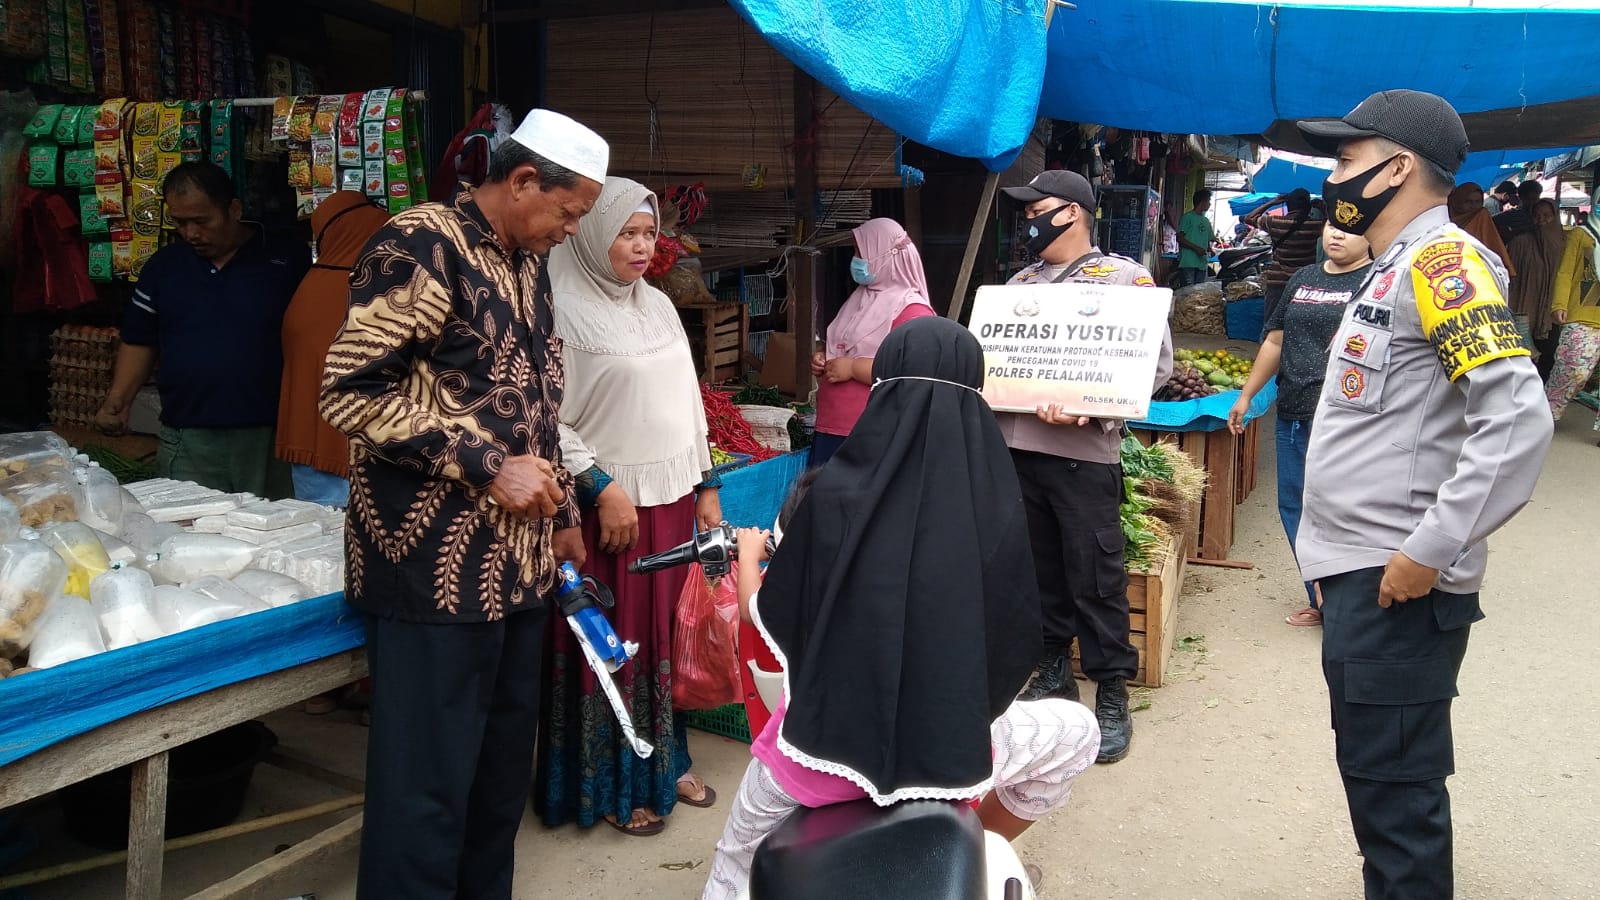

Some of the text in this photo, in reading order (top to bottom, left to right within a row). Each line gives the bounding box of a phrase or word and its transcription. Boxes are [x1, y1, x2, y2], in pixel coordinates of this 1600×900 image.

[1427, 257, 1458, 274] RIAU
[1353, 303, 1391, 327] POLRI
[980, 323, 1146, 343] OPERASI YUSTISI
[981, 344, 1148, 358] DISIPLINAN KEPATUHAN PROTOKOL KESEHATAN
[1466, 342, 1492, 361] AIR
[1007, 356, 1059, 366] PENCEGAHAN
[1061, 358, 1087, 367] COVID
[988, 366, 1113, 384] POLRES PELALAWAN
[1082, 395, 1114, 404] POLSEK
